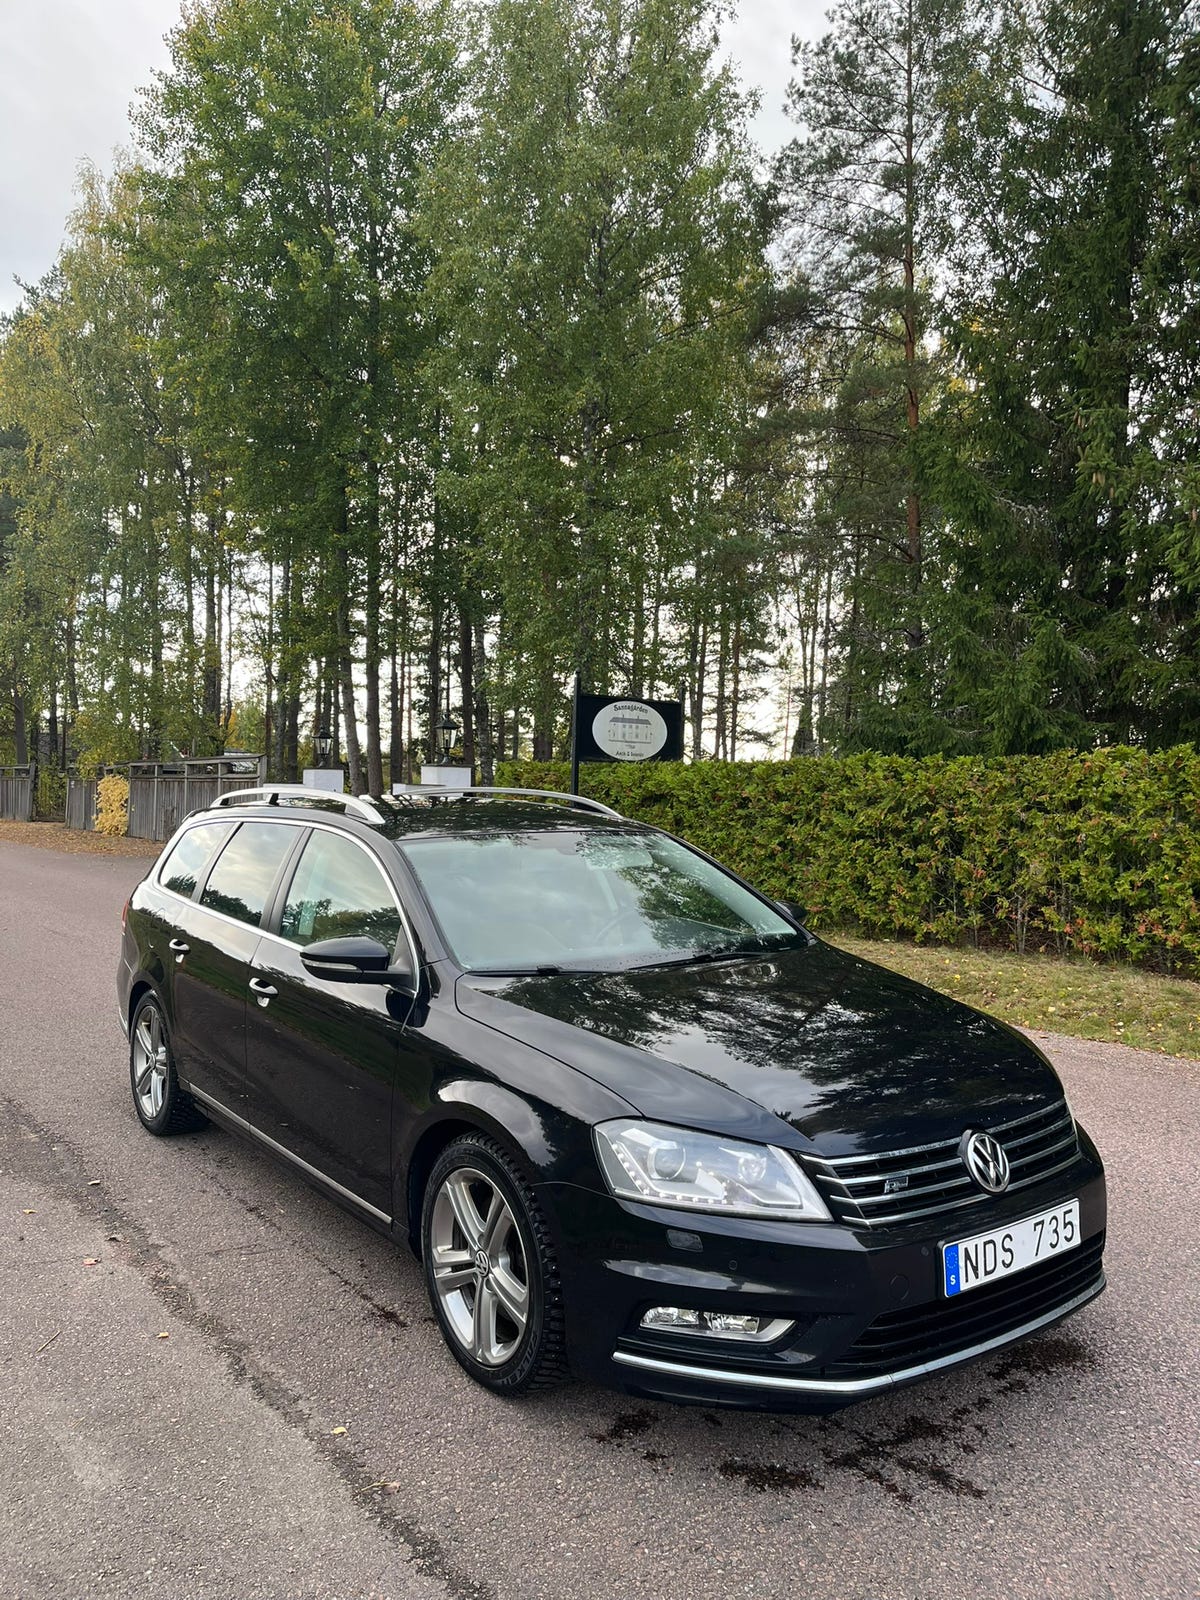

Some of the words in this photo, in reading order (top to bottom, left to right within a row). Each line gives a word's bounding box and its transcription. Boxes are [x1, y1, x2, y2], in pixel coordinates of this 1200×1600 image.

[963, 1233, 1015, 1284] NDS
[1033, 1208, 1075, 1257] 735
[950, 1275, 956, 1285] S
